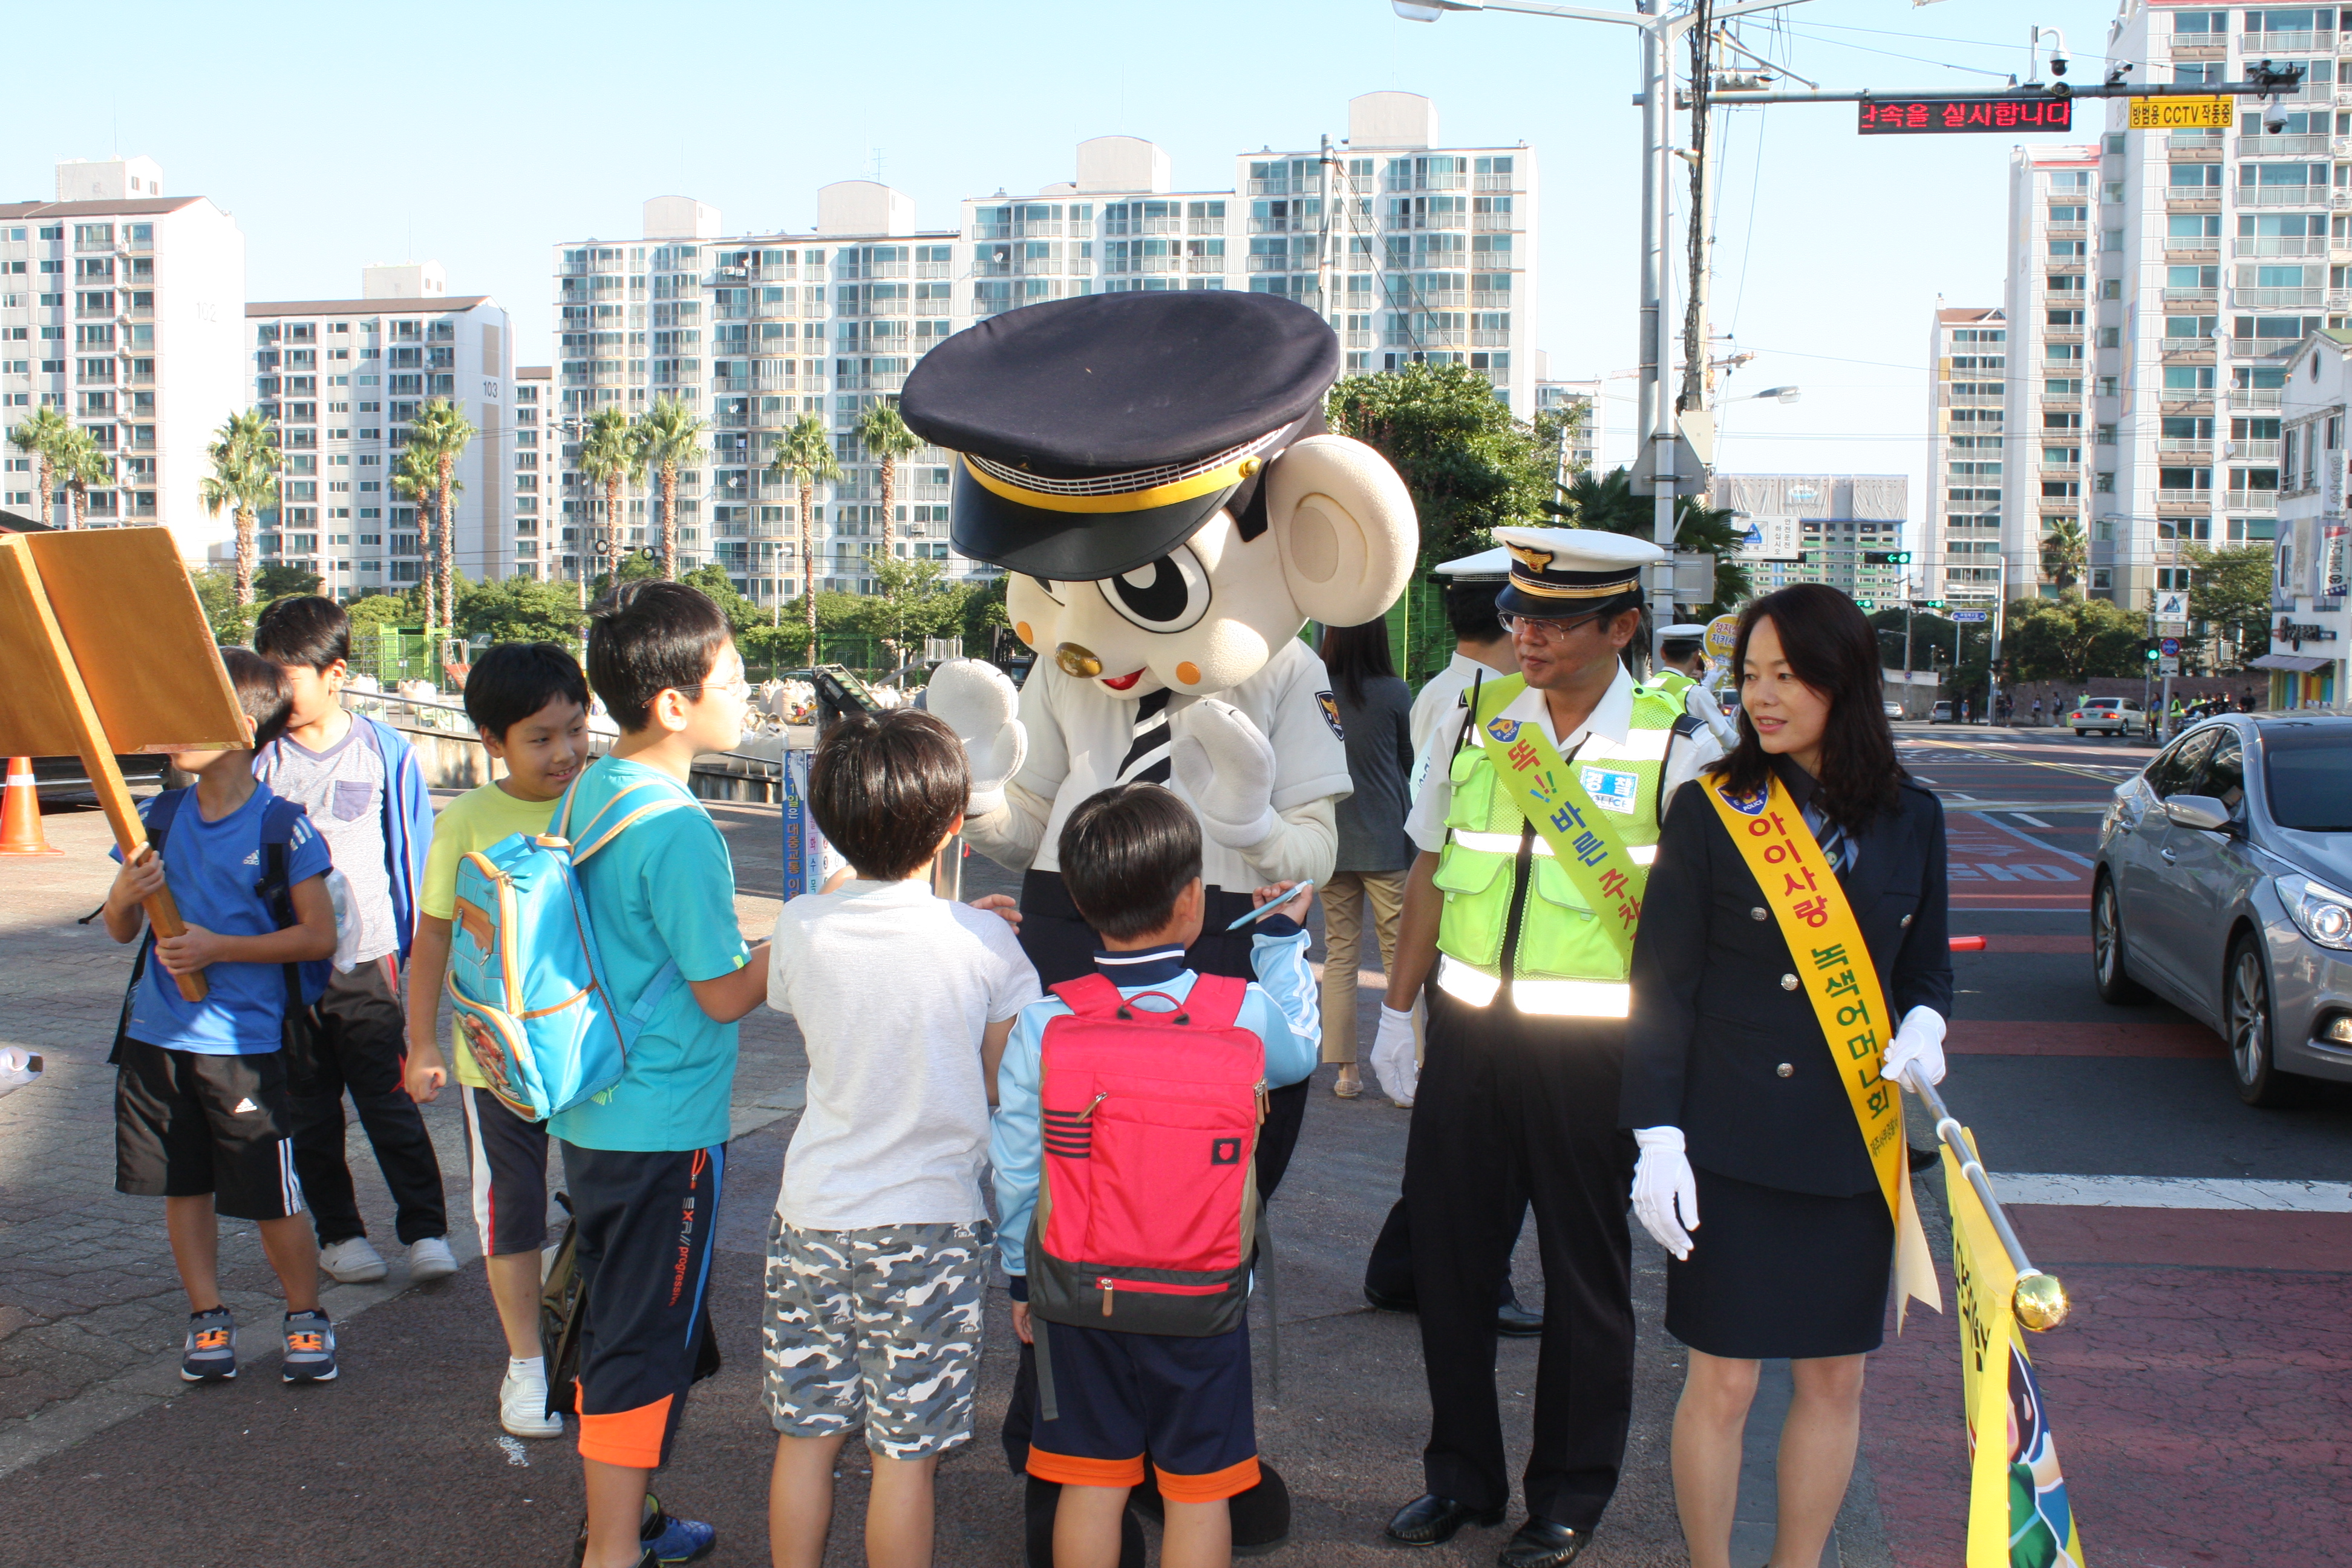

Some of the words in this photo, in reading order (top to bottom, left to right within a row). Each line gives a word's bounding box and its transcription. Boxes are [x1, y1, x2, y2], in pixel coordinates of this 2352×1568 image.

[1942, 101, 2070, 127] 실시합니다
[2133, 104, 2159, 125] 방범용
[2163, 106, 2199, 123] CCTV
[2202, 103, 2230, 123] 작동중
[196, 301, 217, 322] 102
[483, 381, 498, 398] 103
[1503, 727, 1518, 740] POLICE
[1742, 799, 1763, 811] POLICE
[1549, 801, 1608, 867] 바른
[787, 823, 800, 875] 대중교통
[1748, 811, 1828, 928] 아이사랑
[1811, 943, 1890, 1120] 녹색어머니회
